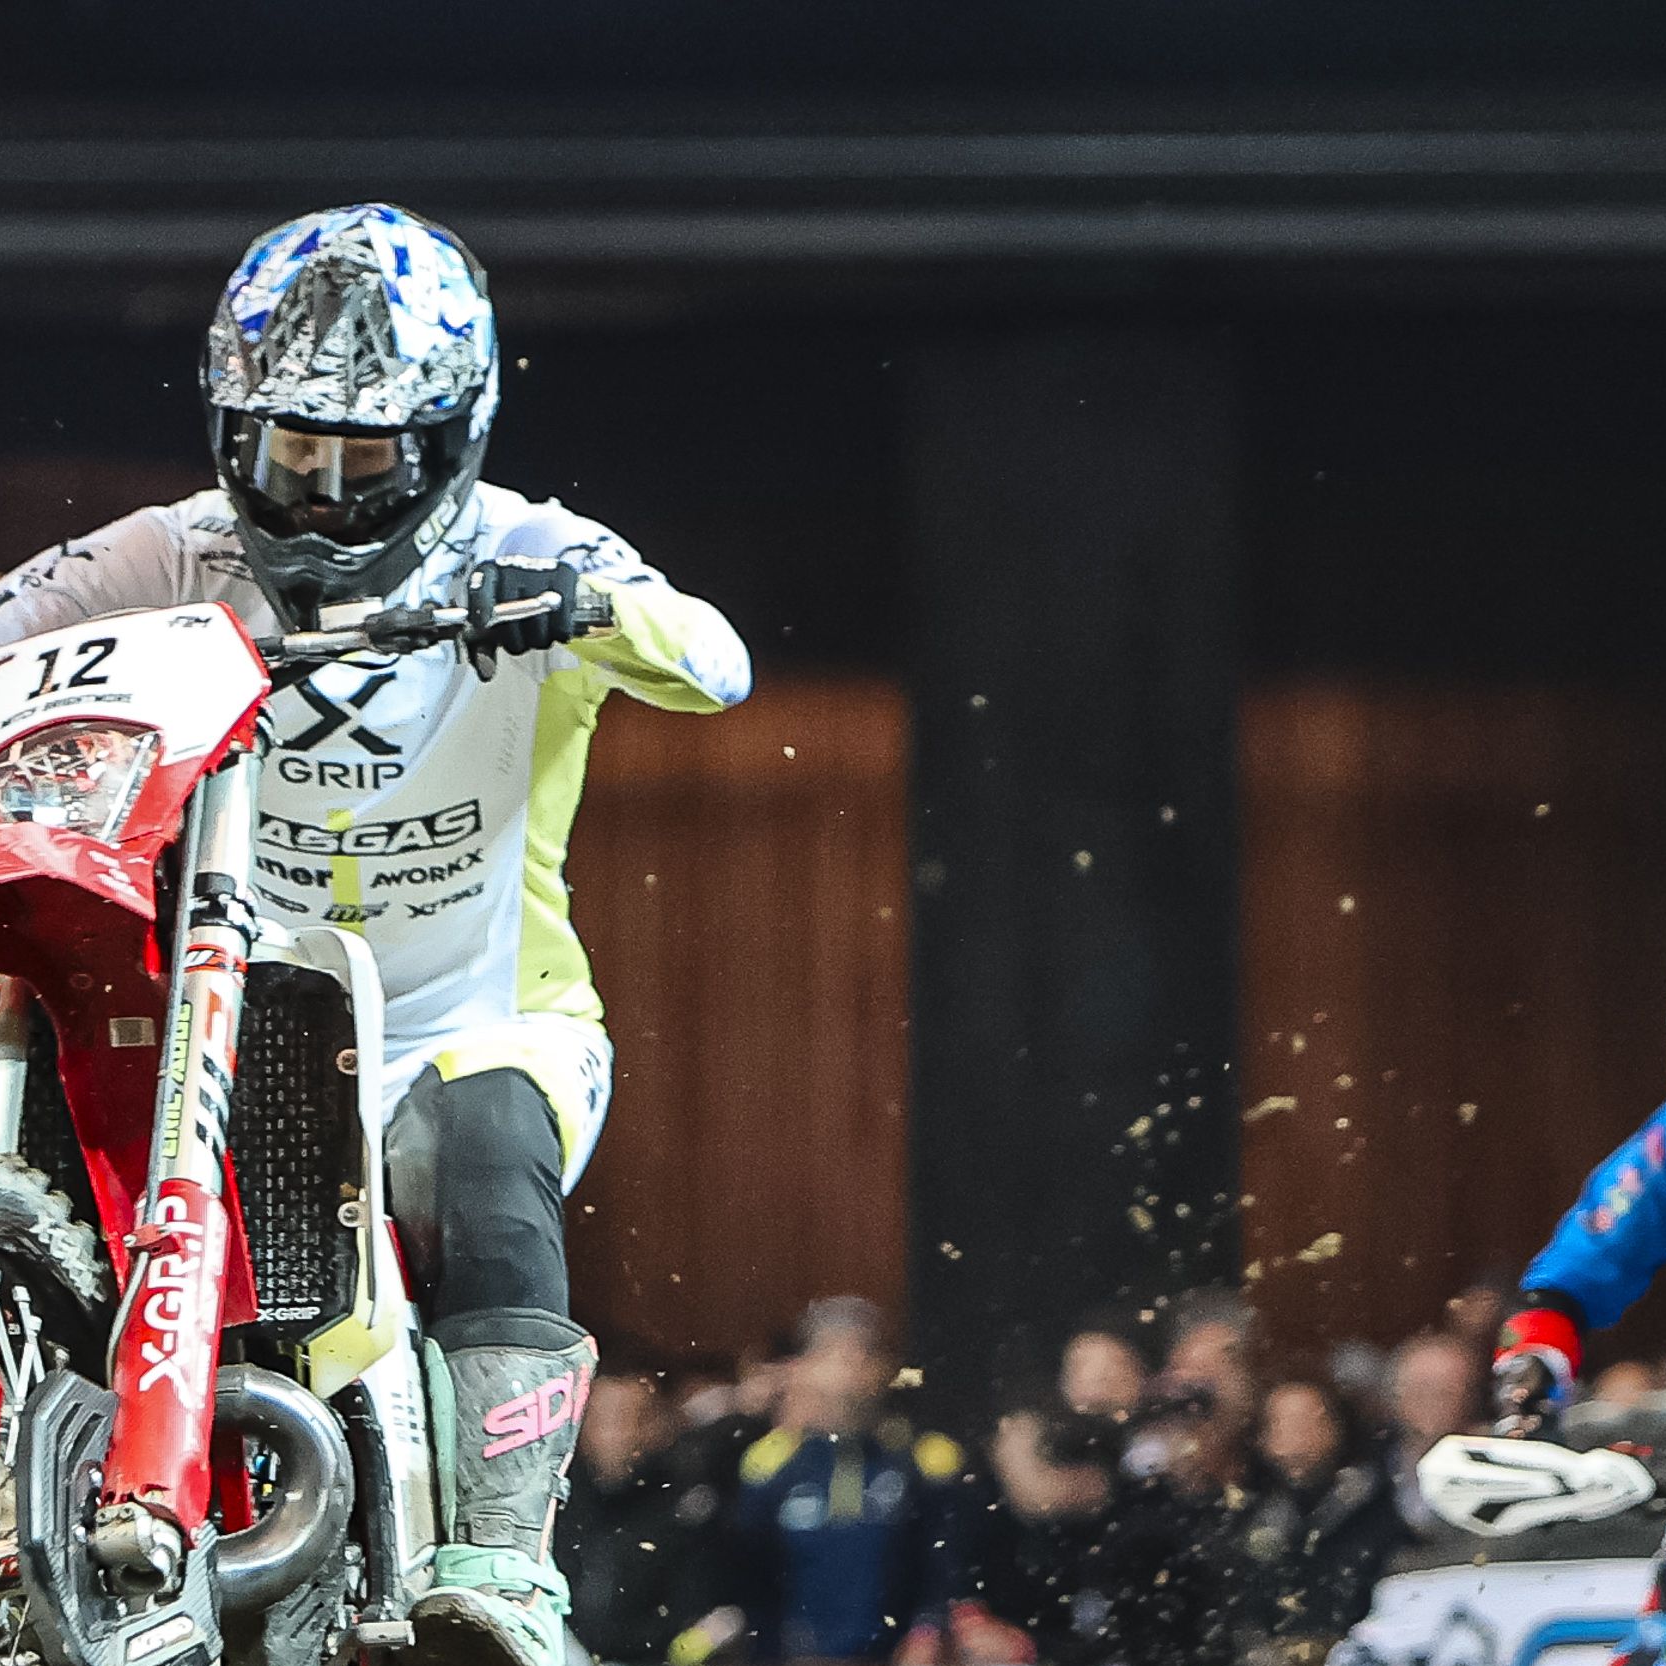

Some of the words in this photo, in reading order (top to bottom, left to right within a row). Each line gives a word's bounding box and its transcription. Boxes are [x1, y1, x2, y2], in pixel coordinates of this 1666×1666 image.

[26, 637, 118, 700] 12
[278, 756, 405, 791] GRIP
[256, 802, 479, 855] ASGAS
[256, 1305, 321, 1322] X-GRIP
